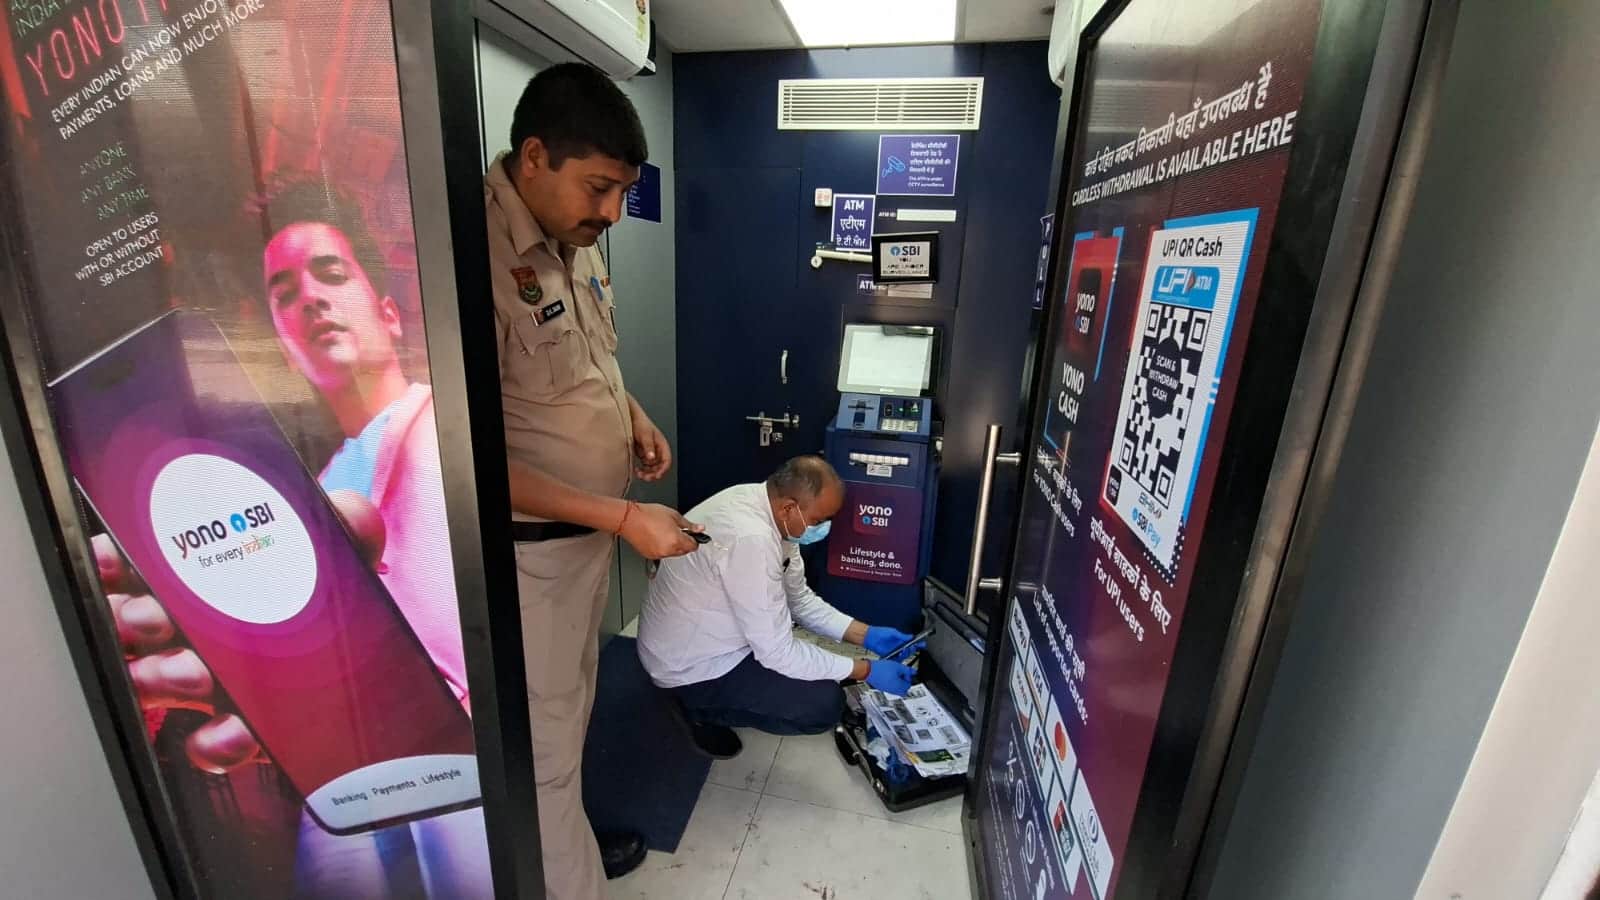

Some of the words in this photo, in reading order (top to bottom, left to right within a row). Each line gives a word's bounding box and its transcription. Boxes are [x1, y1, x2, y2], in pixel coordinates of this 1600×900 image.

[51, 92, 81, 123] EVERY
[81, 64, 122, 100] INDIAN
[122, 44, 150, 72] CAN
[149, 21, 181, 53] NOW
[181, 0, 228, 30] ENJOY
[59, 95, 117, 140] PAYMENTS,
[113, 64, 155, 101] LOANS
[154, 46, 182, 75] AND
[182, 20, 224, 56] MUCH
[1098, 145, 1115, 173] रहित
[1114, 140, 1137, 164] नकद
[1135, 112, 1175, 157] निकासी
[1175, 96, 1203, 140] यहाँ
[1199, 80, 1255, 130] उपलब्ध
[1072, 182, 1102, 206] CARDLESS
[1101, 163, 1154, 198] WITHDRAWAL
[1155, 157, 1168, 182] IS
[1166, 130, 1242, 179] AVAILABLE
[1241, 110, 1297, 156] HERE
[843, 200, 865, 211] ATM
[86, 235, 113, 257] OPEN
[112, 228, 128, 243] TO
[127, 211, 160, 235] USERS
[839, 214, 867, 232] एटीएम
[74, 261, 100, 281] WITH
[99, 244, 116, 268] OR
[114, 228, 161, 260] WITHOUT
[902, 246, 921, 256] SBI
[1163, 239, 1179, 257] UPI
[1179, 237, 1195, 258] QR
[1195, 235, 1223, 257] Cash
[98, 271, 116, 287] SBI
[115, 245, 164, 279] ACCOUNT
[1074, 292, 1096, 313] yono
[1079, 316, 1091, 334] SBI
[1062, 362, 1085, 395] YONO
[1156, 354, 1172, 370] SCAN
[1058, 390, 1080, 424] CASH
[1152, 386, 1168, 402] CASH
[859, 504, 893, 517] yono
[872, 516, 888, 527] SBI
[172, 518, 228, 560] yono
[244, 502, 276, 529] SBI
[1136, 511, 1149, 533] SBI
[1146, 522, 1161, 549] Pay
[198, 555, 214, 569] for
[214, 545, 245, 562] every
[841, 555, 877, 568] banking,
[879, 559, 903, 570] dono.
[850, 546, 886, 559] Lifestyle
[888, 551, 895, 560] &
[1094, 557, 1107, 585] For
[1106, 574, 1122, 606] UPI
[1119, 599, 1145, 642] users
[1139, 574, 1152, 602] के
[1150, 590, 1172, 635] लिए
[332, 789, 369, 807] Banking
[371, 779, 417, 797] Payments
[421, 768, 462, 786] Lifestyle
